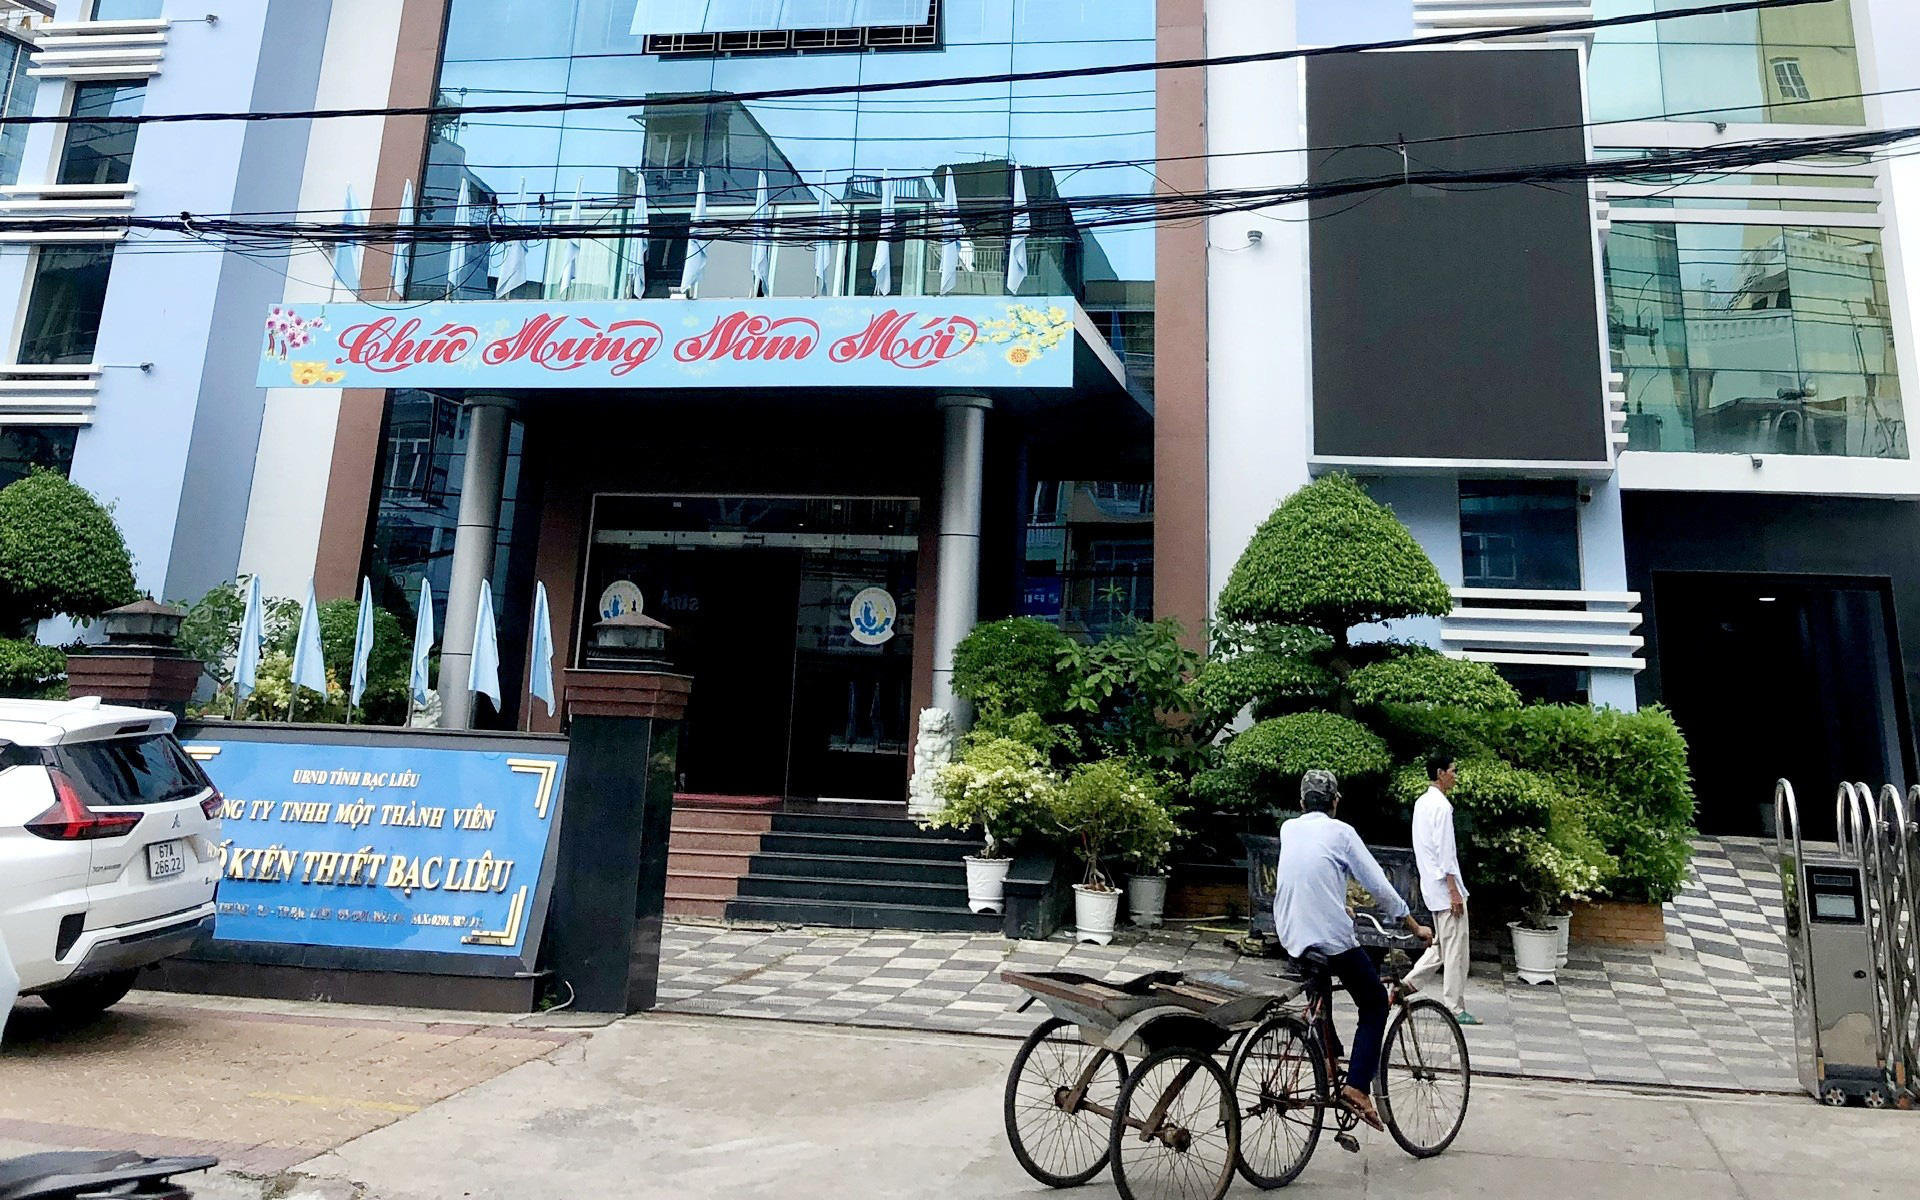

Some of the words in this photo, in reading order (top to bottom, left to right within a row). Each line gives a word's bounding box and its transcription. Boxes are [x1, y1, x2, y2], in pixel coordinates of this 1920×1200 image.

[336, 316, 478, 373] Chúc
[482, 312, 663, 377] Mừng
[673, 310, 820, 363] Năm
[828, 308, 977, 369] Mới
[292, 769, 328, 785] UBND
[361, 772, 389, 792] BẠC
[388, 768, 421, 788] LIÊU
[219, 799, 246, 821] NG
[249, 800, 276, 821] TY
[280, 802, 332, 823] TNHH
[334, 798, 376, 830] MỘT
[380, 800, 446, 828] THÀNH
[453, 802, 497, 831] VIÊN
[159, 844, 175, 859] 67A
[154, 857, 182, 876] 266.22
[224, 843, 299, 883] KIẾN
[300, 845, 387, 887] THIẾT
[384, 855, 443, 897] BẠC
[442, 850, 514, 893] LIÊU
